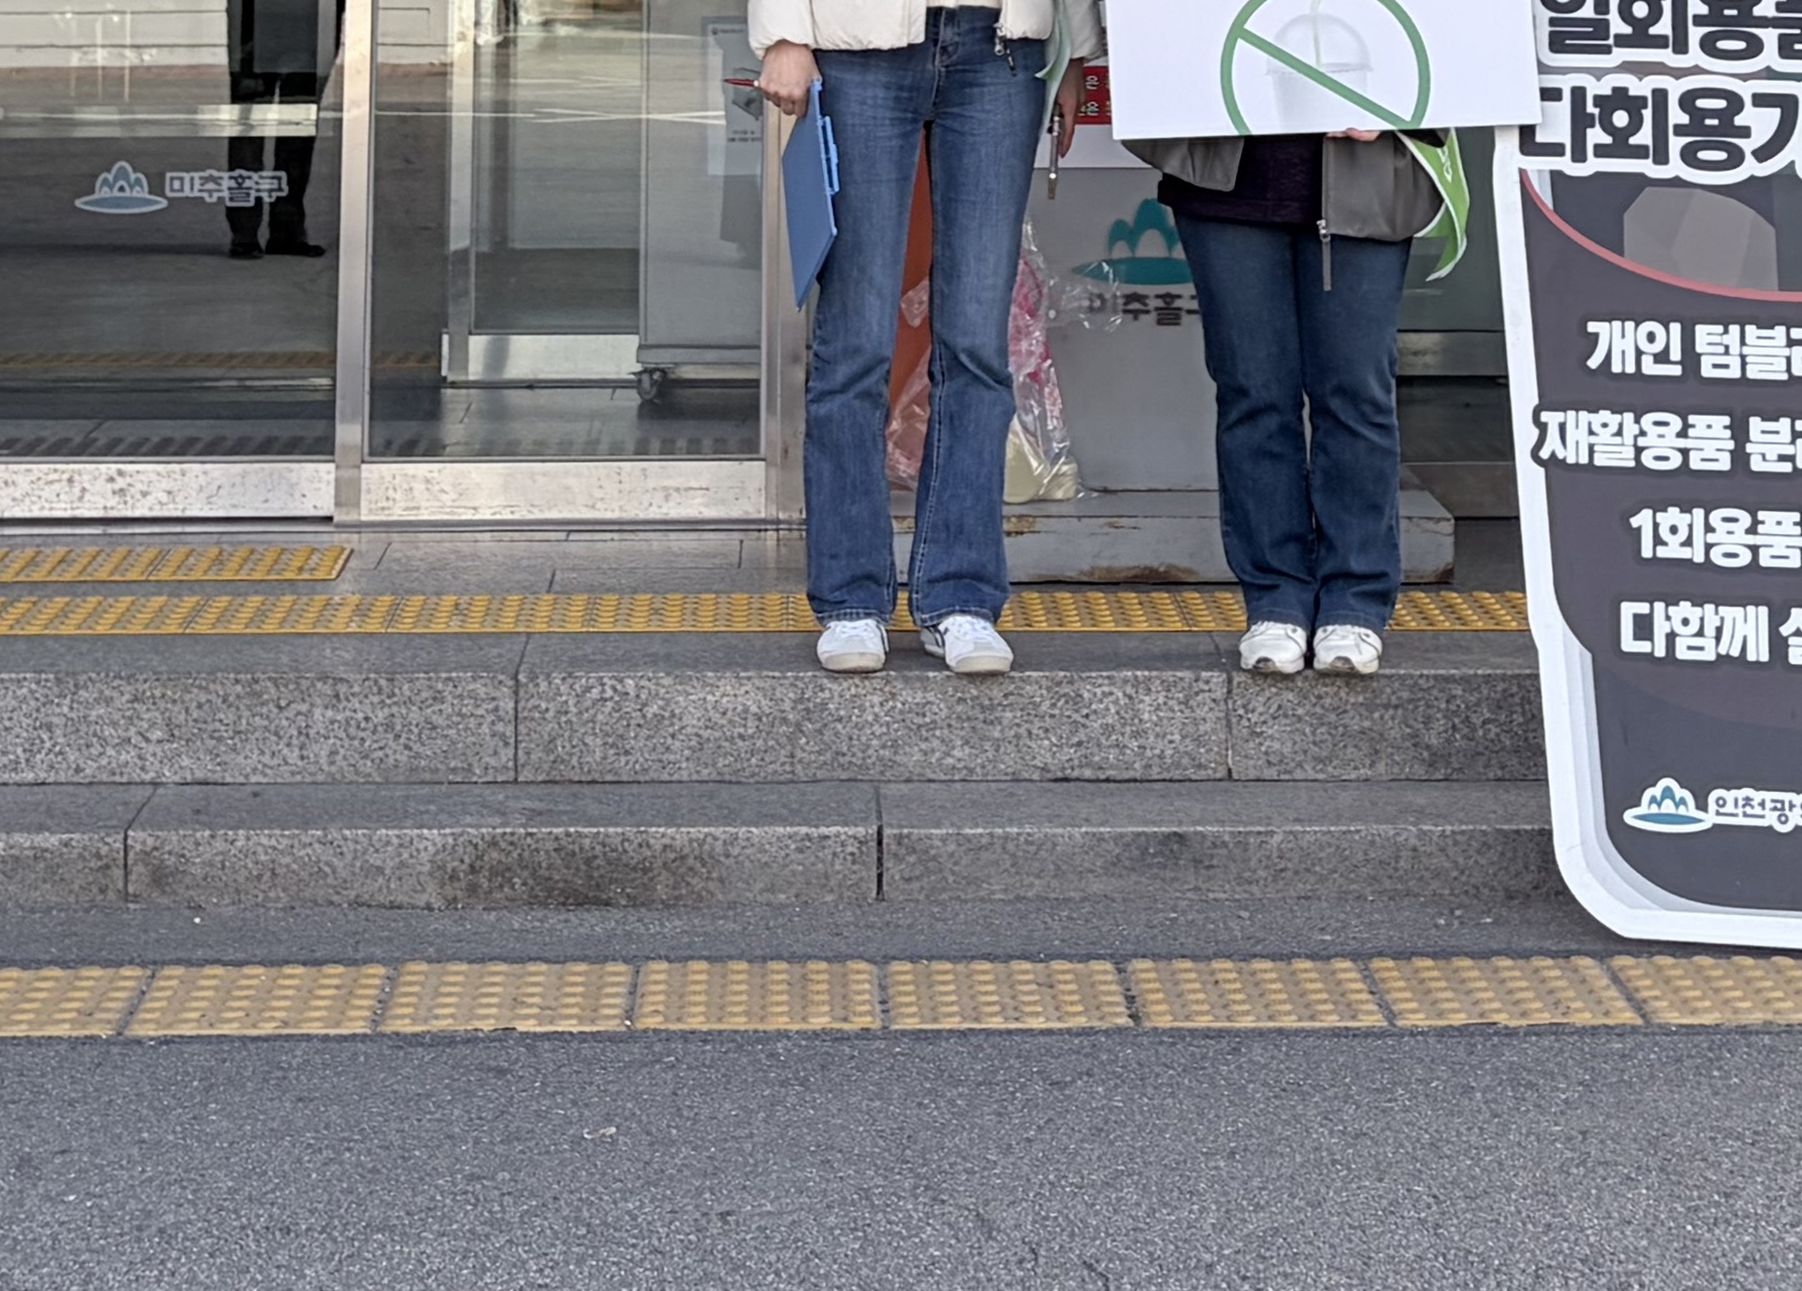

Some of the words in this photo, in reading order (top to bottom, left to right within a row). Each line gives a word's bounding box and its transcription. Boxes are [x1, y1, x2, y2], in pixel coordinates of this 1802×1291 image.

[165, 169, 289, 207] 미추홀구
[1586, 320, 1683, 377] 개인
[1538, 409, 1735, 471] 재활용품
[1620, 600, 1770, 663] 다함께
